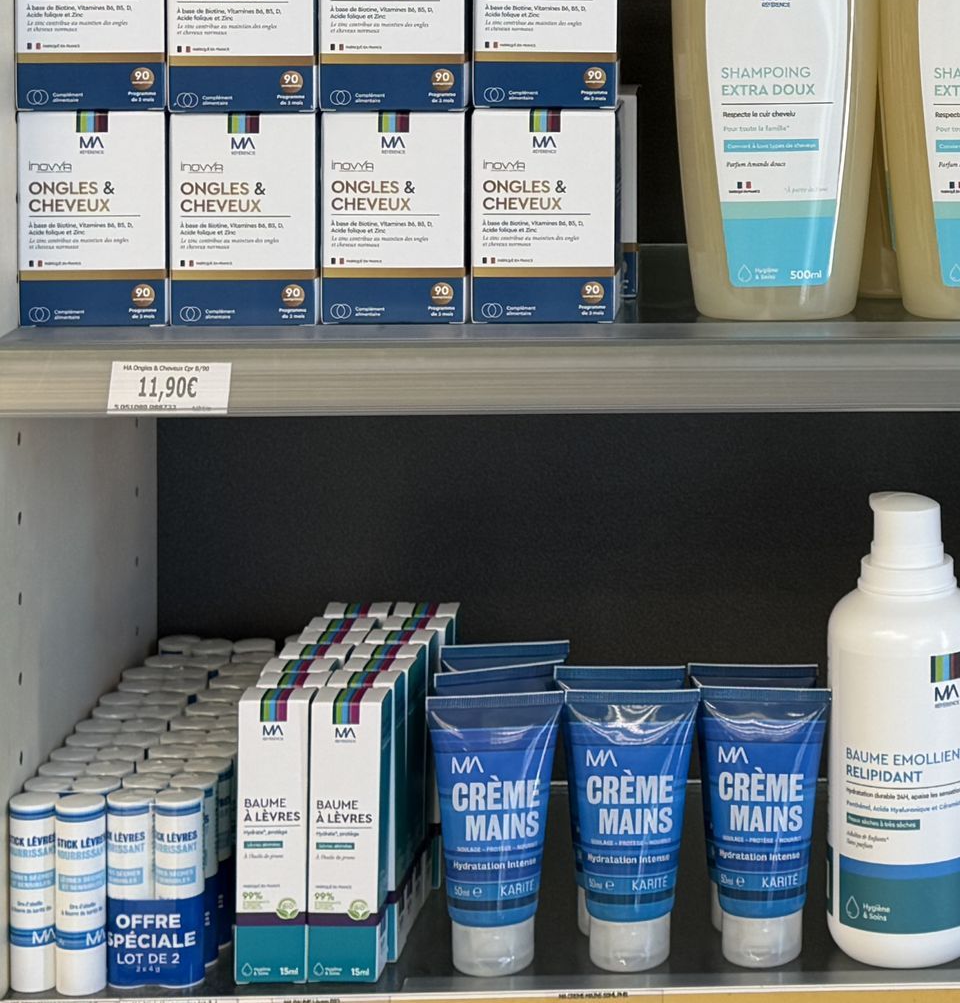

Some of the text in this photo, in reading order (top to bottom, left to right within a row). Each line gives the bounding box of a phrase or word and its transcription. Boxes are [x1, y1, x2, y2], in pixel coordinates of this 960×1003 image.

[135, 71, 150, 81] 90
[721, 66, 811, 80] SHAMPOING
[721, 83, 816, 97] EXTRA DOUX
[723, 110, 751, 119] Respecte
[759, 110, 772, 118] cuir
[773, 110, 796, 118] chevelu
[28, 182, 115, 195] ONGLES &
[28, 199, 111, 213] CHEVEUX
[790, 269, 822, 280] 500ml
[138, 376, 198, 402] 11,90€
[718, 746, 749, 764] MA
[846, 747, 889, 766] BAUME
[846, 764, 923, 783] RELIPIDANT
[586, 769, 674, 805] CRÈME
[718, 767, 804, 802] CRÈME
[452, 775, 541, 812] CRÈME
[244, 798, 287, 810] BAUME
[316, 800, 359, 811] BAUME
[244, 808, 301, 822] À LÈVRES
[316, 810, 373, 824] À LÈVRES
[598, 806, 673, 835] MAINS
[730, 804, 803, 833] MAINS
[465, 811, 540, 842] MAINS
[719, 850, 800, 862] Hydratation Intense
[762, 873, 799, 888] KARITÉ
[116, 914, 181, 929] OFFRE
[108, 930, 196, 949] SPÉCIALE
[117, 953, 180, 965] LOT DE 2
[280, 966, 299, 976] 15ml
